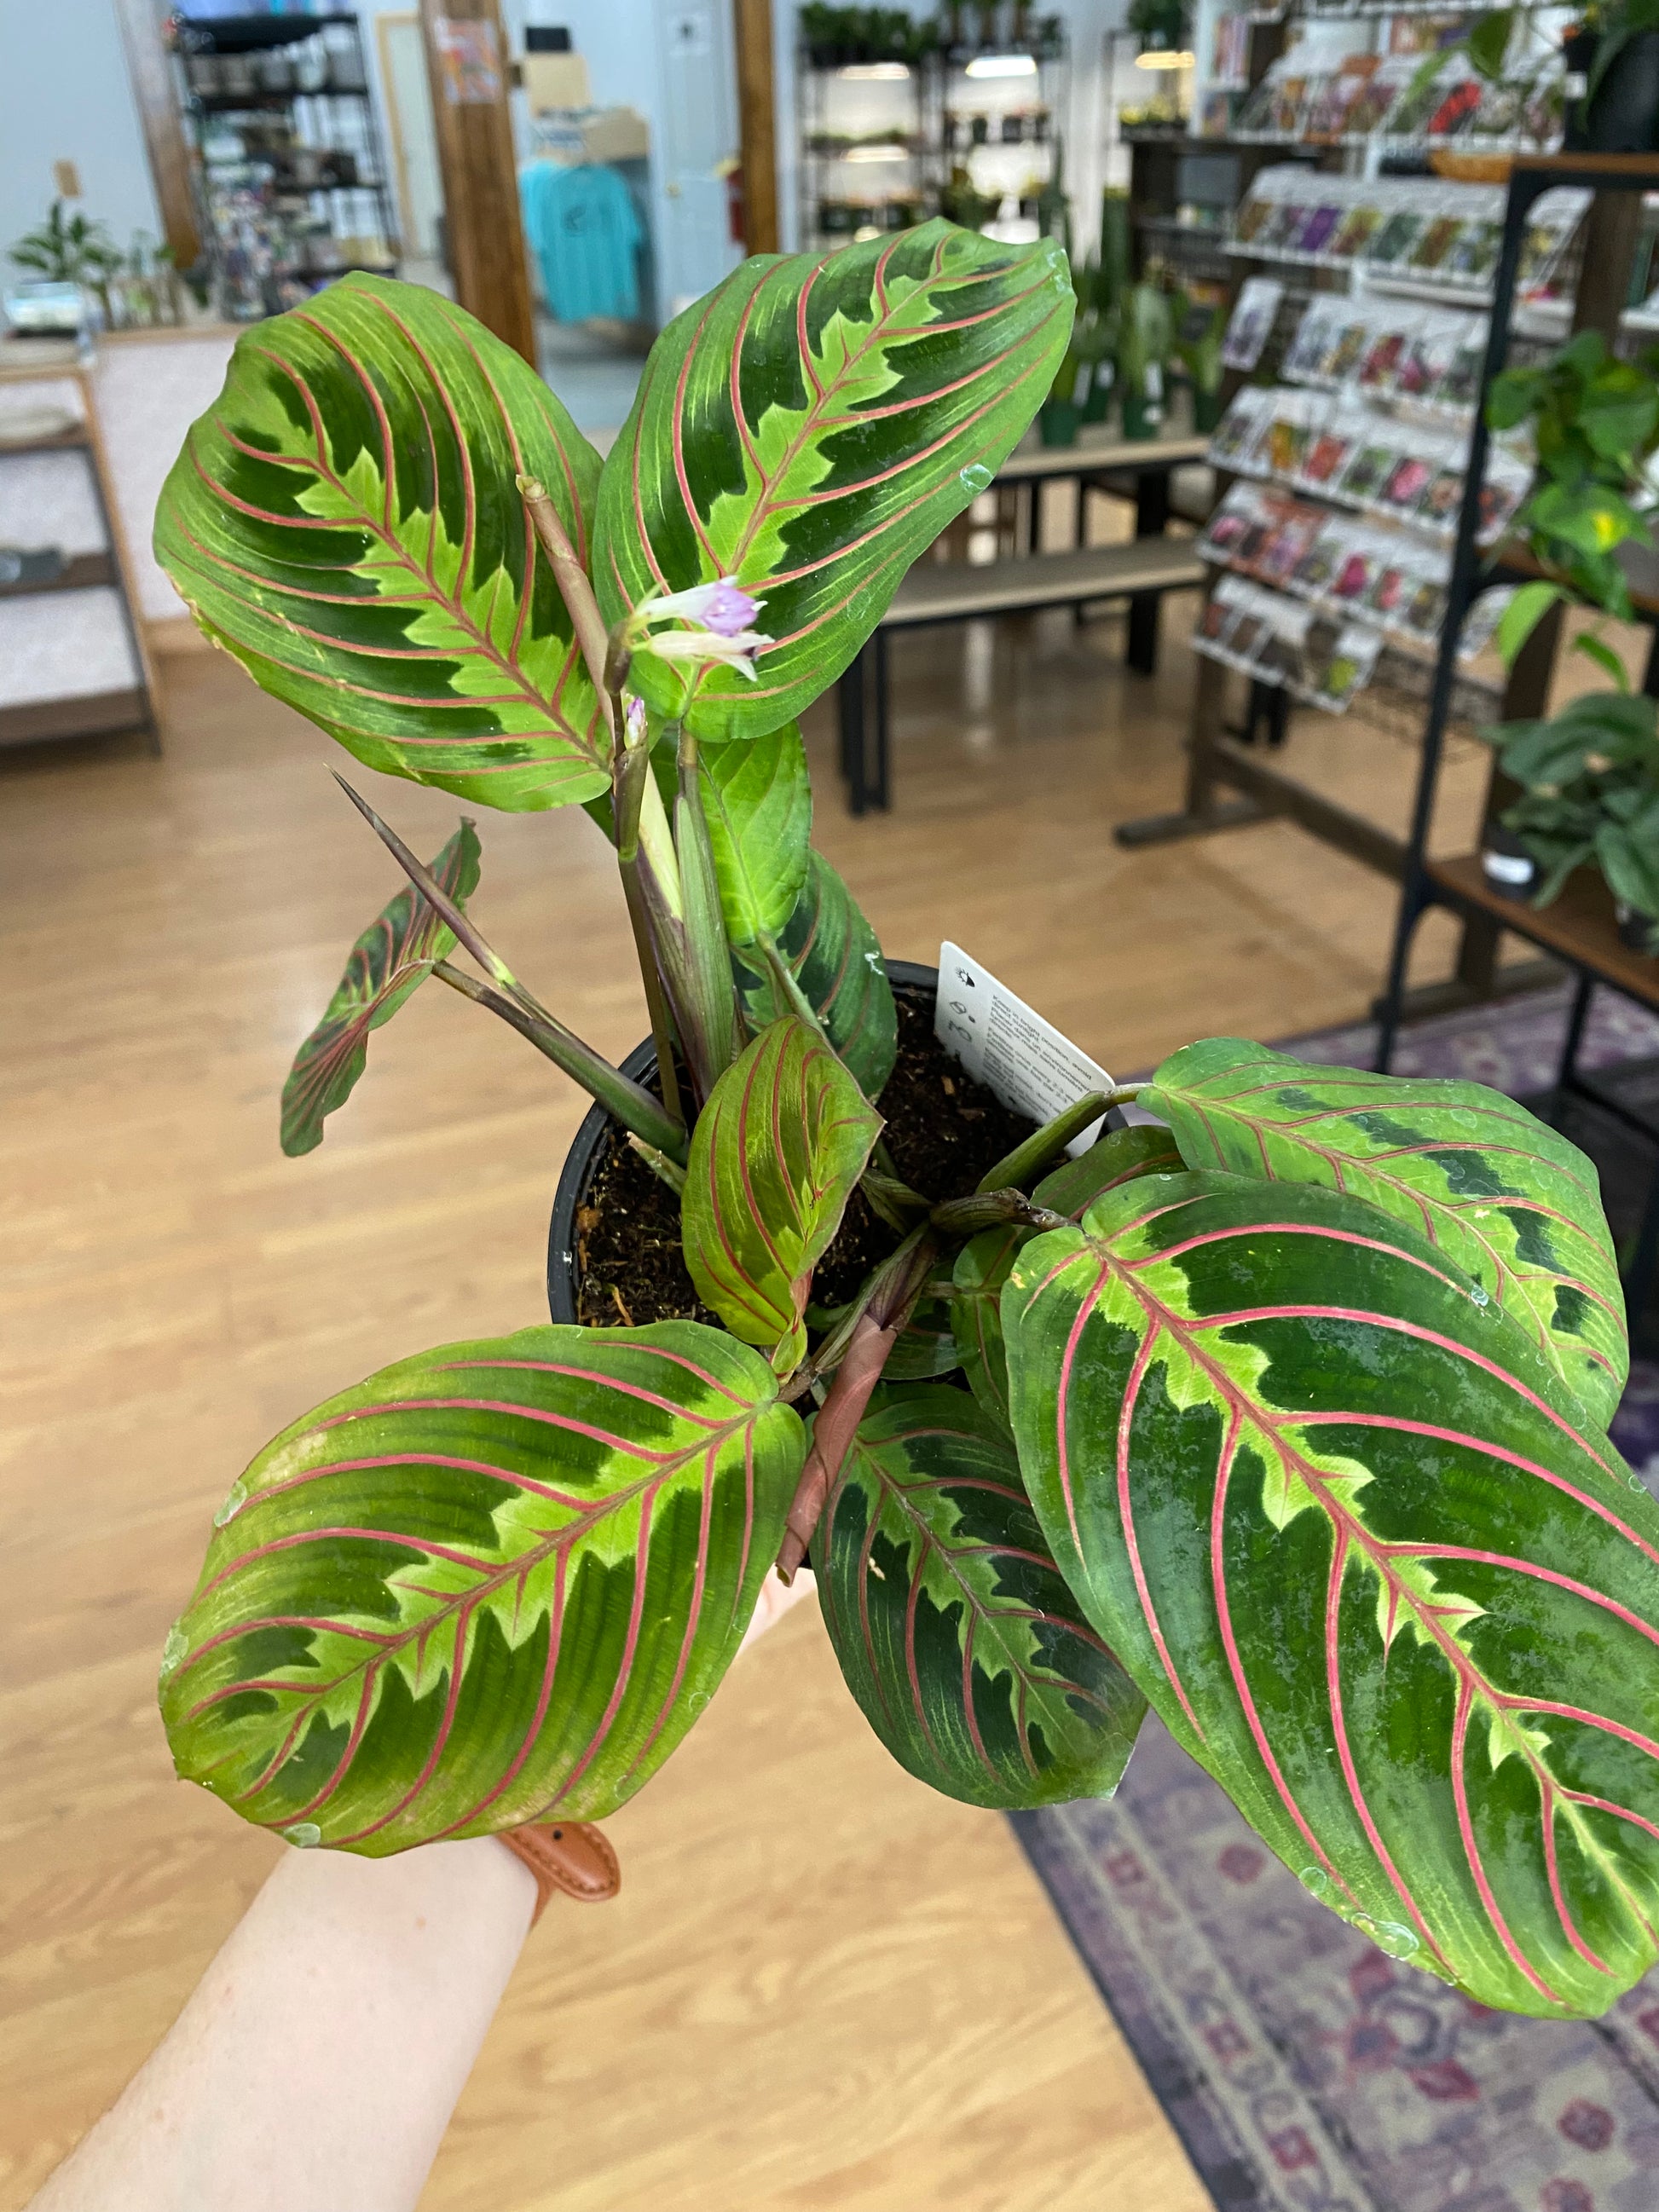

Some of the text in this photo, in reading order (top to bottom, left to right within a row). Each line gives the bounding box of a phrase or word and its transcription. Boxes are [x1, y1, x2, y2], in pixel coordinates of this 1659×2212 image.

[991, 1000, 1010, 1018] direct
[992, 995, 1011, 1012] Keep
[1020, 1018, 1040, 1037] bright
[1072, 1061, 1091, 1080] avoid
[1032, 1042, 1041, 1051] un
